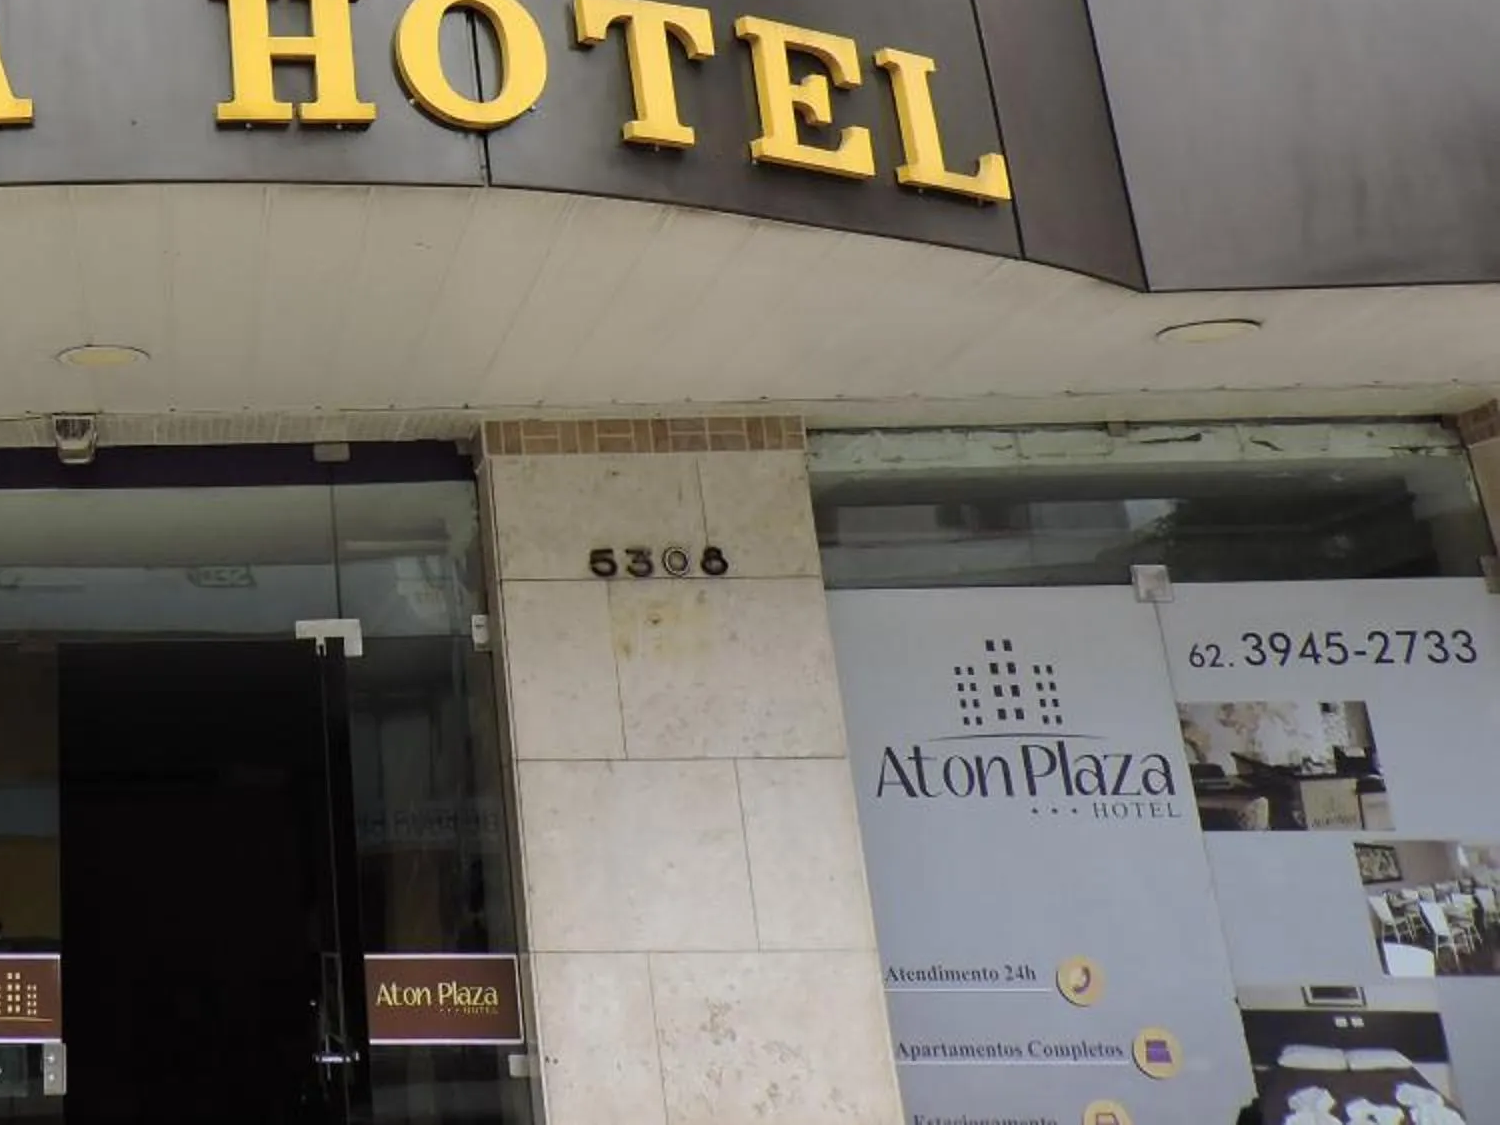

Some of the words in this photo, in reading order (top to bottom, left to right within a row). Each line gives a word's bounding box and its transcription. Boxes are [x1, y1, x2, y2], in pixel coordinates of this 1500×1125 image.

[589, 545, 729, 577] 5308
[1092, 801, 1183, 819] HOTEL
[884, 964, 1000, 983] Atendimento
[1004, 963, 1037, 982] 24h
[376, 980, 432, 1006] Aton
[437, 980, 499, 1006] Plaza
[897, 1040, 1023, 1061] Apartamentos
[1027, 1039, 1124, 1061] Completos
